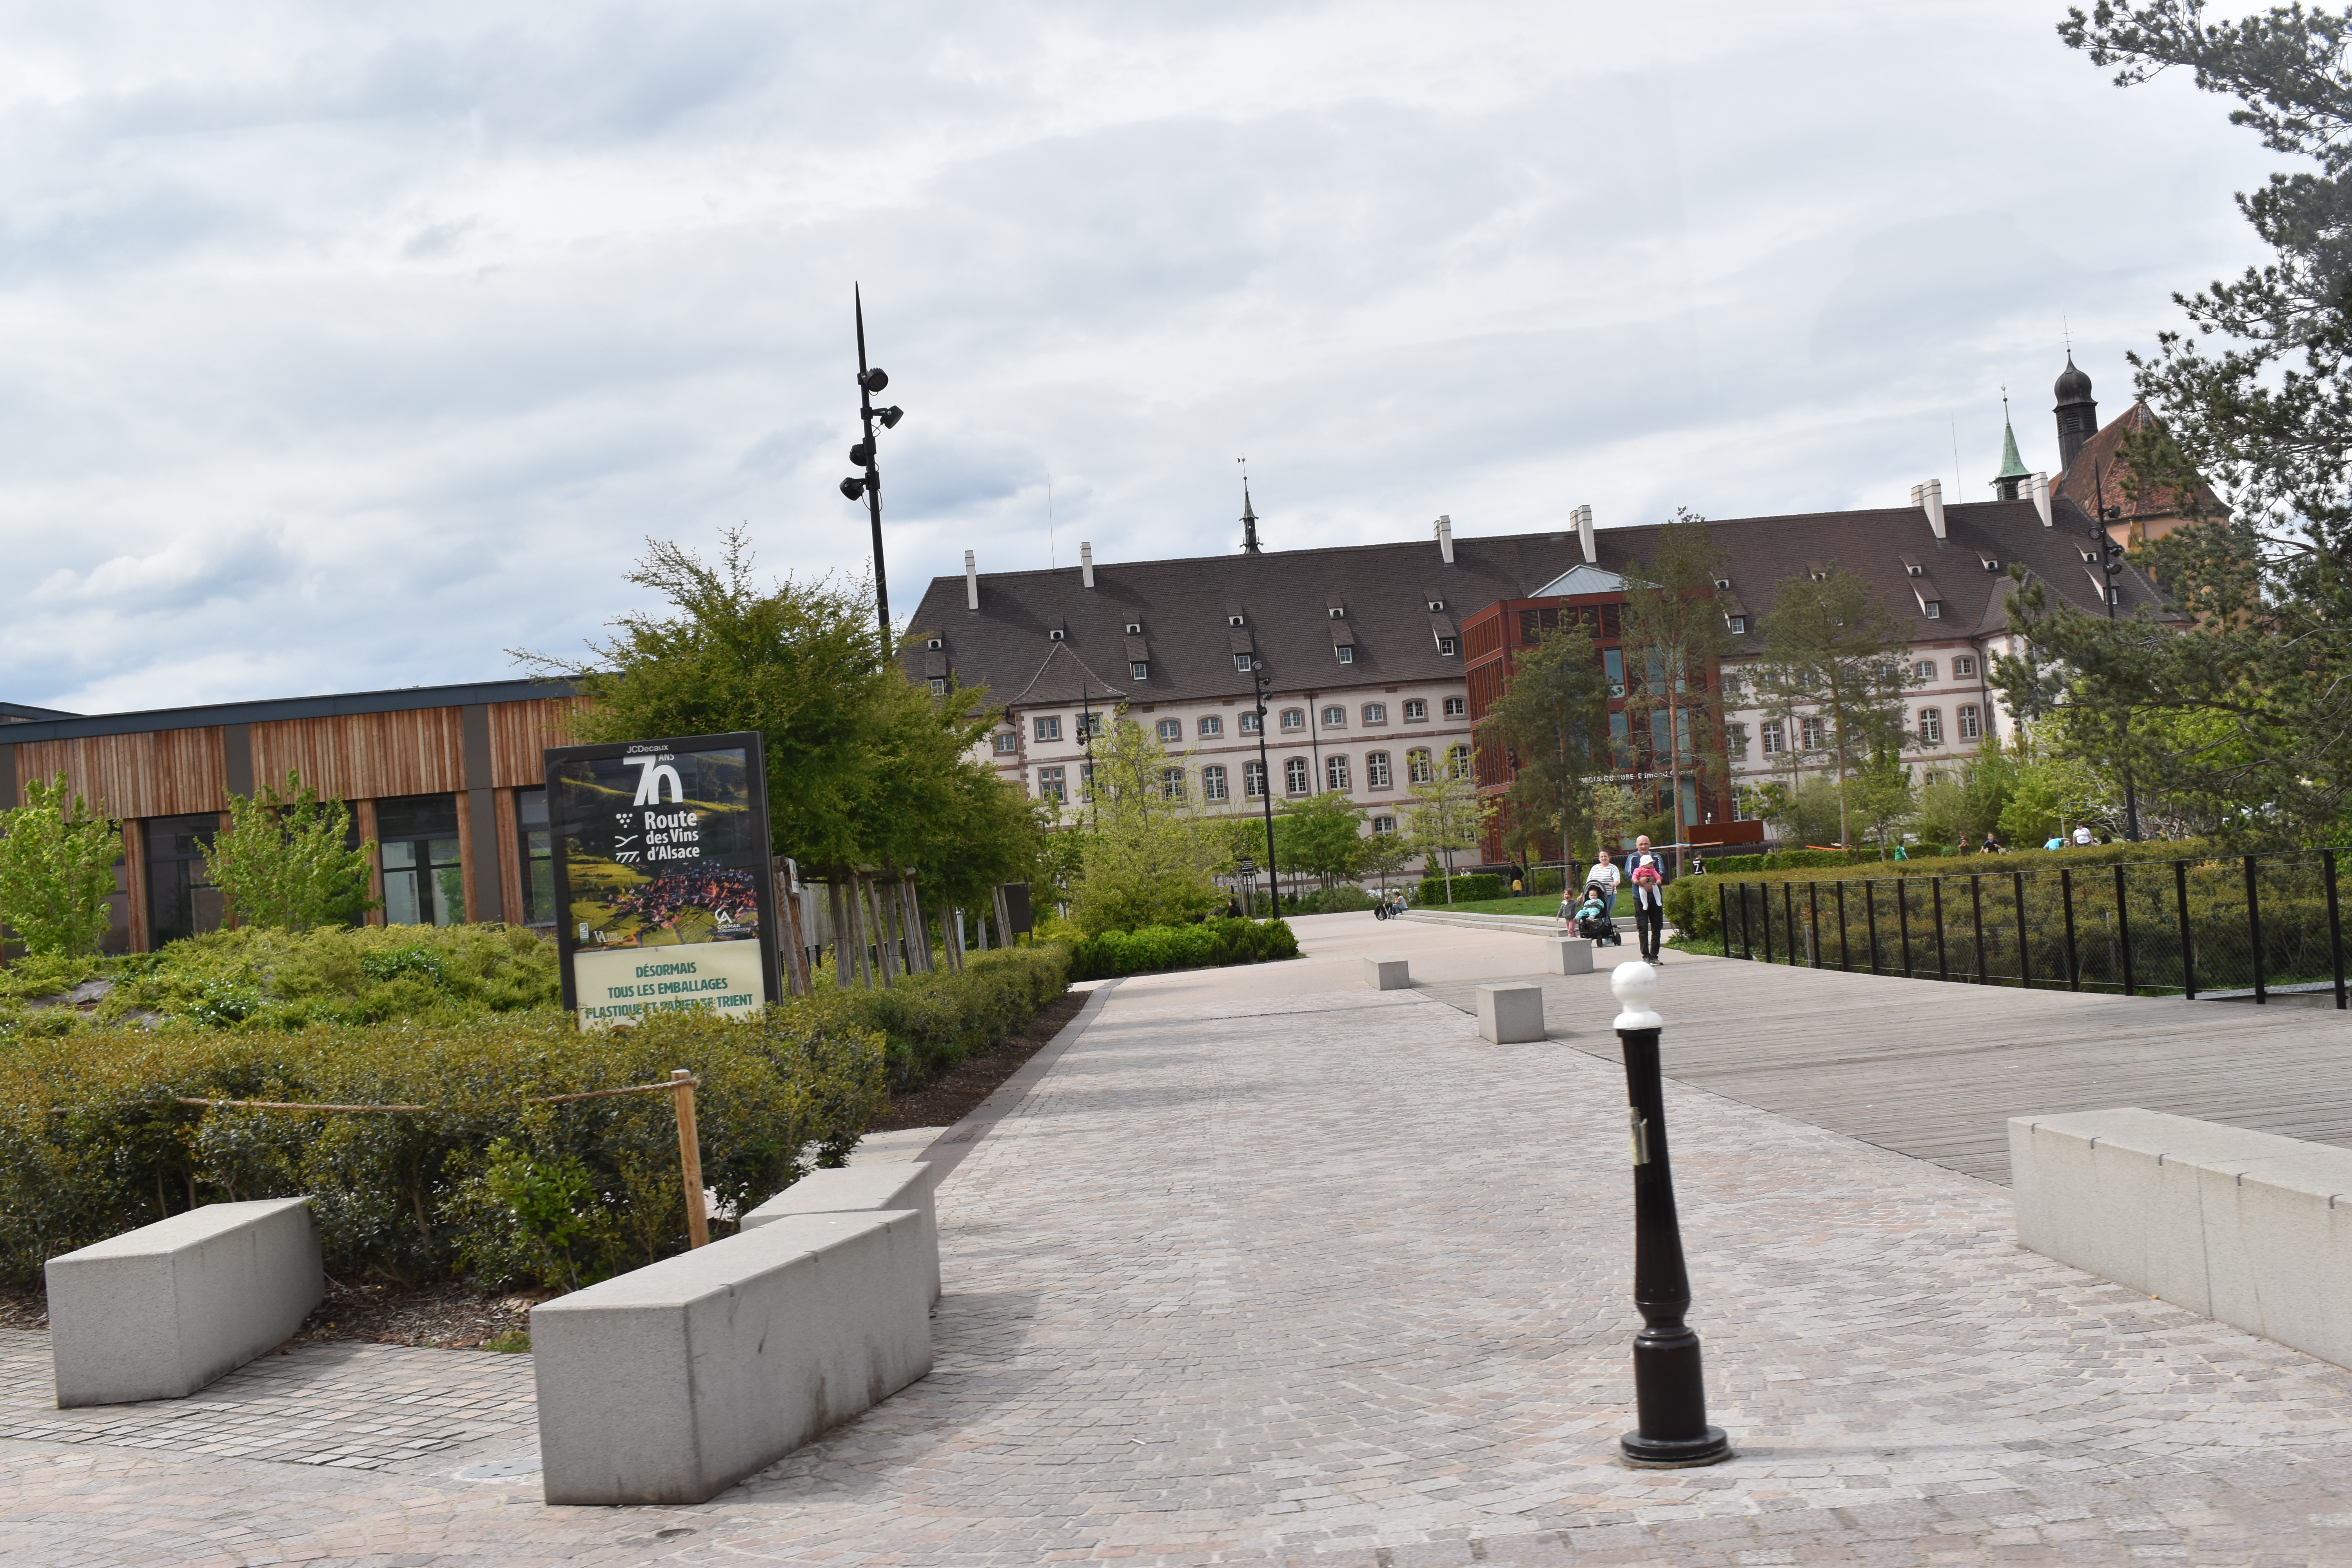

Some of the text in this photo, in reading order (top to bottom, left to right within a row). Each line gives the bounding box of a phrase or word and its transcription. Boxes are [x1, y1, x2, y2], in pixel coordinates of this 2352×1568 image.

[626, 745, 669, 753] JCDecaux
[658, 753, 675, 761] ANS
[644, 810, 697, 830] Route
[646, 828, 699, 844] des Vins
[647, 845, 700, 861] d'Alsace
[1694, 864, 1699, 872] 7
[593, 931, 607, 943] VA
[635, 962, 697, 978] DÉSORMAIS
[608, 978, 728, 998] TOUS LES EMBALLAGES
[585, 1004, 642, 1019] PLASTIQUE
[716, 994, 753, 1007] TRIENT
